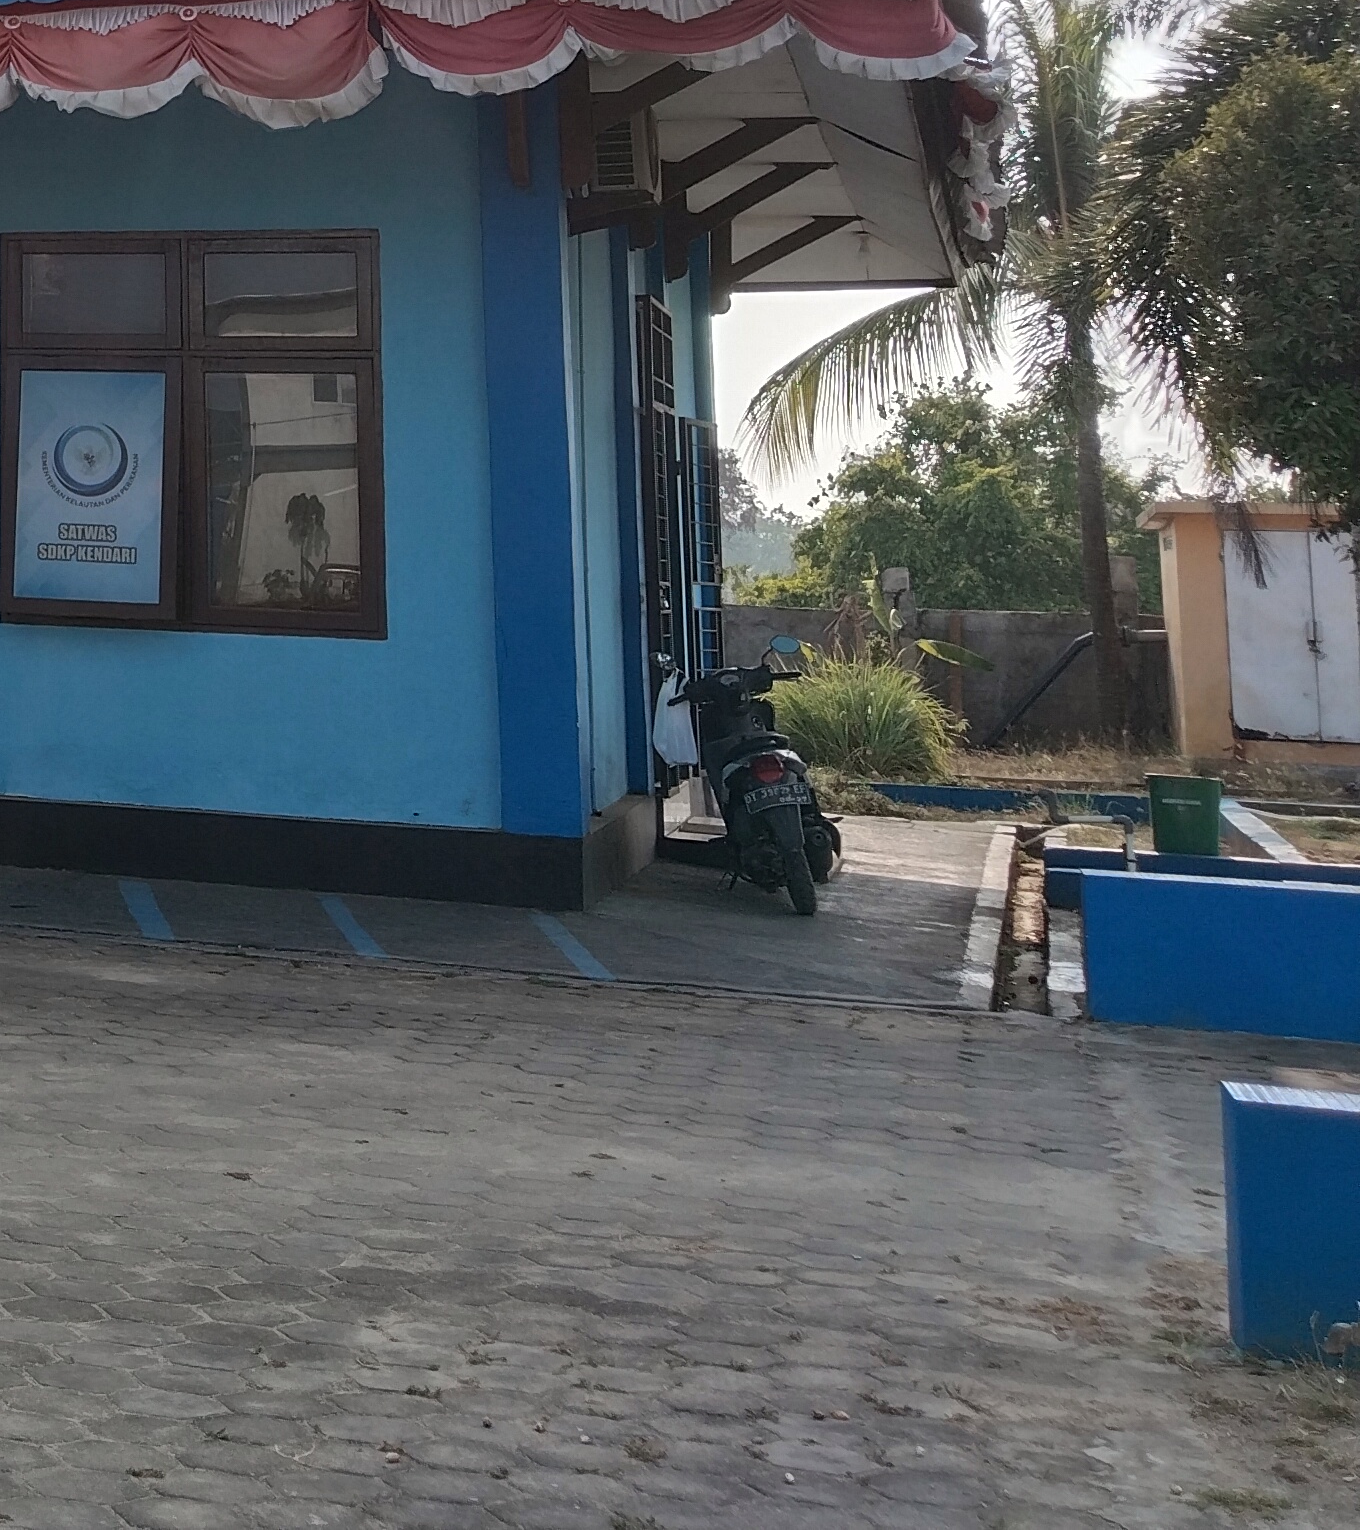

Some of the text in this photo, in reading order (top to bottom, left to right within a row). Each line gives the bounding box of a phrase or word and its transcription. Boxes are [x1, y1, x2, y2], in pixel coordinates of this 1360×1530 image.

[41, 450, 65, 499] KEMENTERIAN
[65, 496, 105, 508] KELAUTAN
[120, 453, 139, 495] PERIKANAN
[58, 523, 117, 542] SATWAS
[37, 543, 137, 565] SDKP KENDARI
